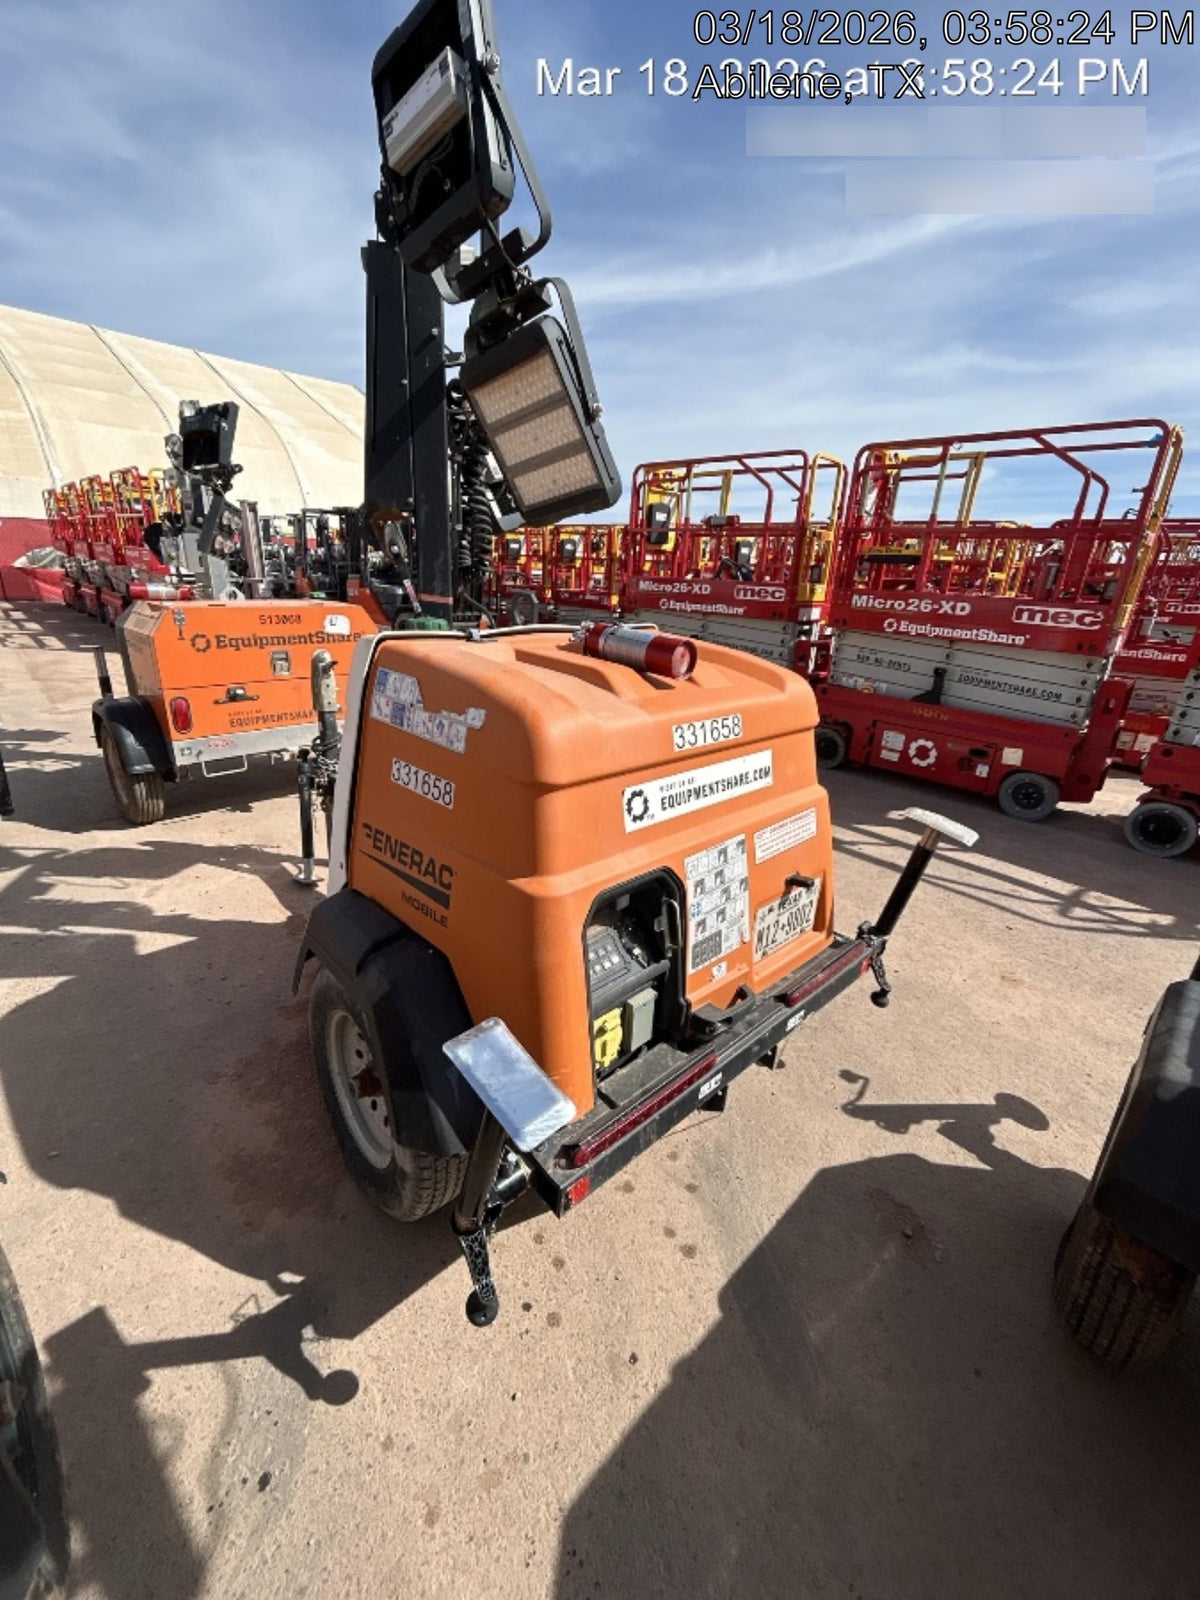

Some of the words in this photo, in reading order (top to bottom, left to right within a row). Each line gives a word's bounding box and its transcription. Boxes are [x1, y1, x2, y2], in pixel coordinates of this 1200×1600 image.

[851, 594, 971, 616] Micro26-XD
[899, 619, 1025, 646] EquipmentShare
[674, 714, 742, 750] 331658
[392, 760, 453, 807] 331658
[660, 765, 771, 811] EQUIPMENTSHARE.COM
[401, 890, 449, 929] MOBILE
